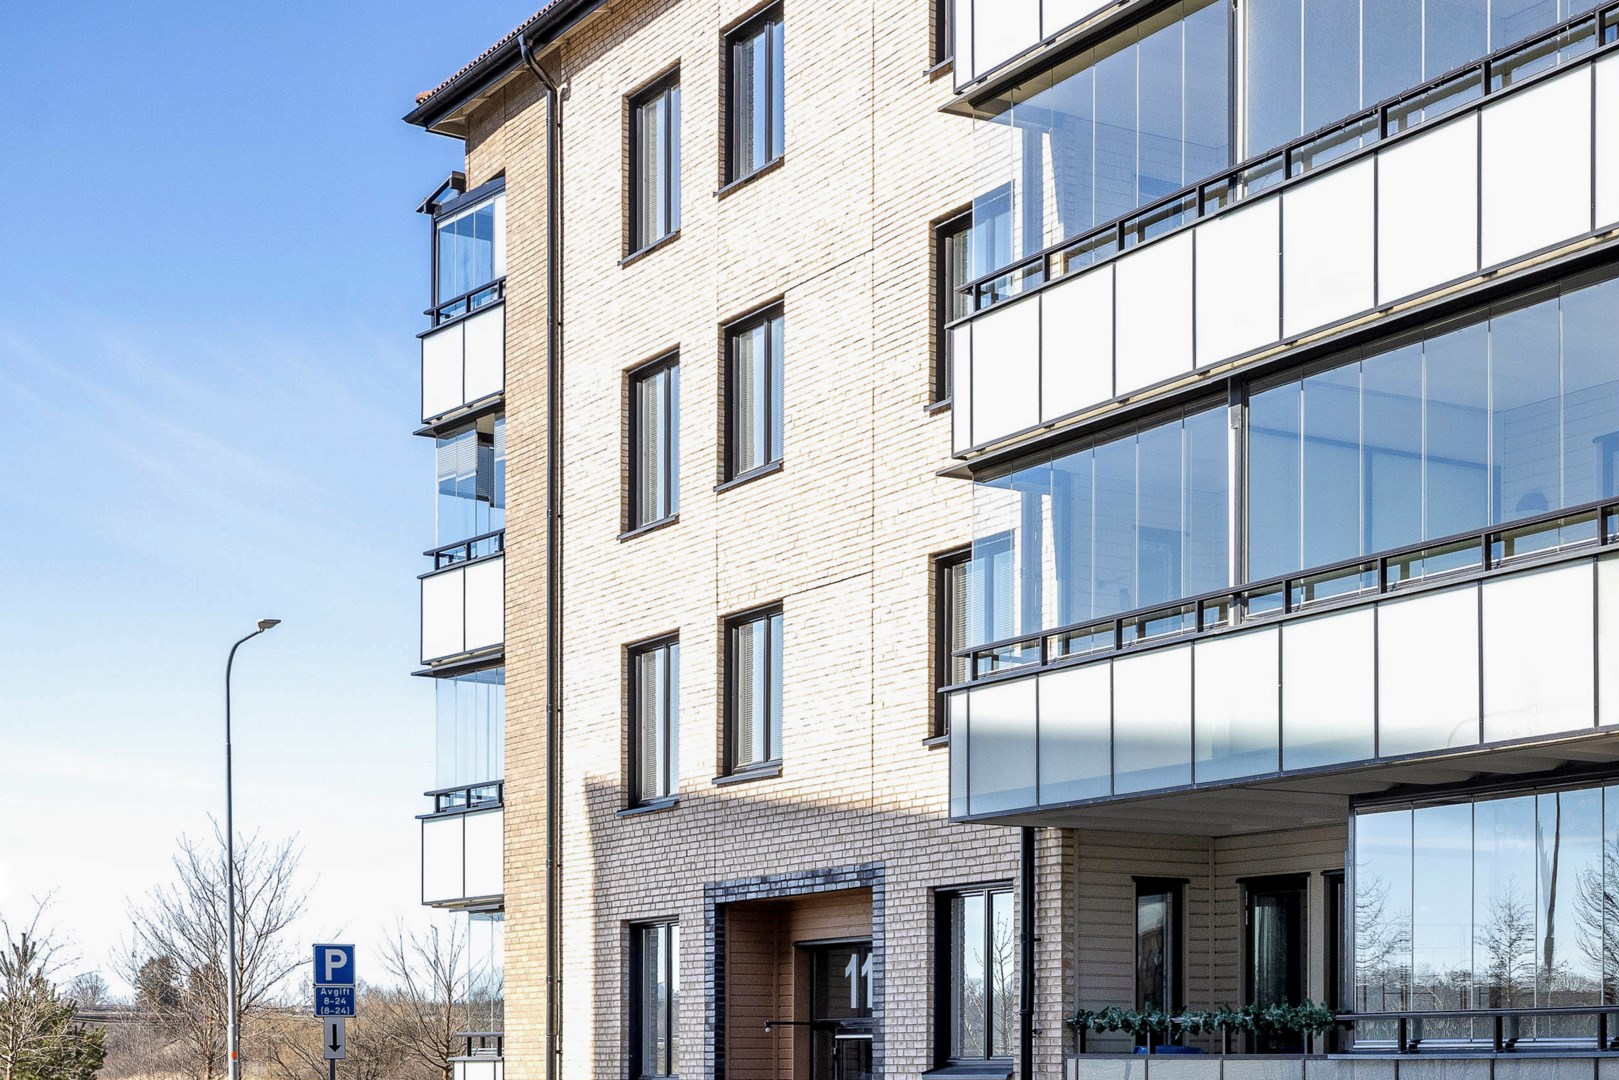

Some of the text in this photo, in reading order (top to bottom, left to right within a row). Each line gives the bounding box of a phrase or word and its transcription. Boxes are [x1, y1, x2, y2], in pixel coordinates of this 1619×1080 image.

[325, 949, 348, 981] P
[845, 952, 873, 1009] 11
[320, 987, 350, 997] Avgift
[323, 997, 347, 1005] 8-24
[320, 1006, 350, 1015] (8-24)
